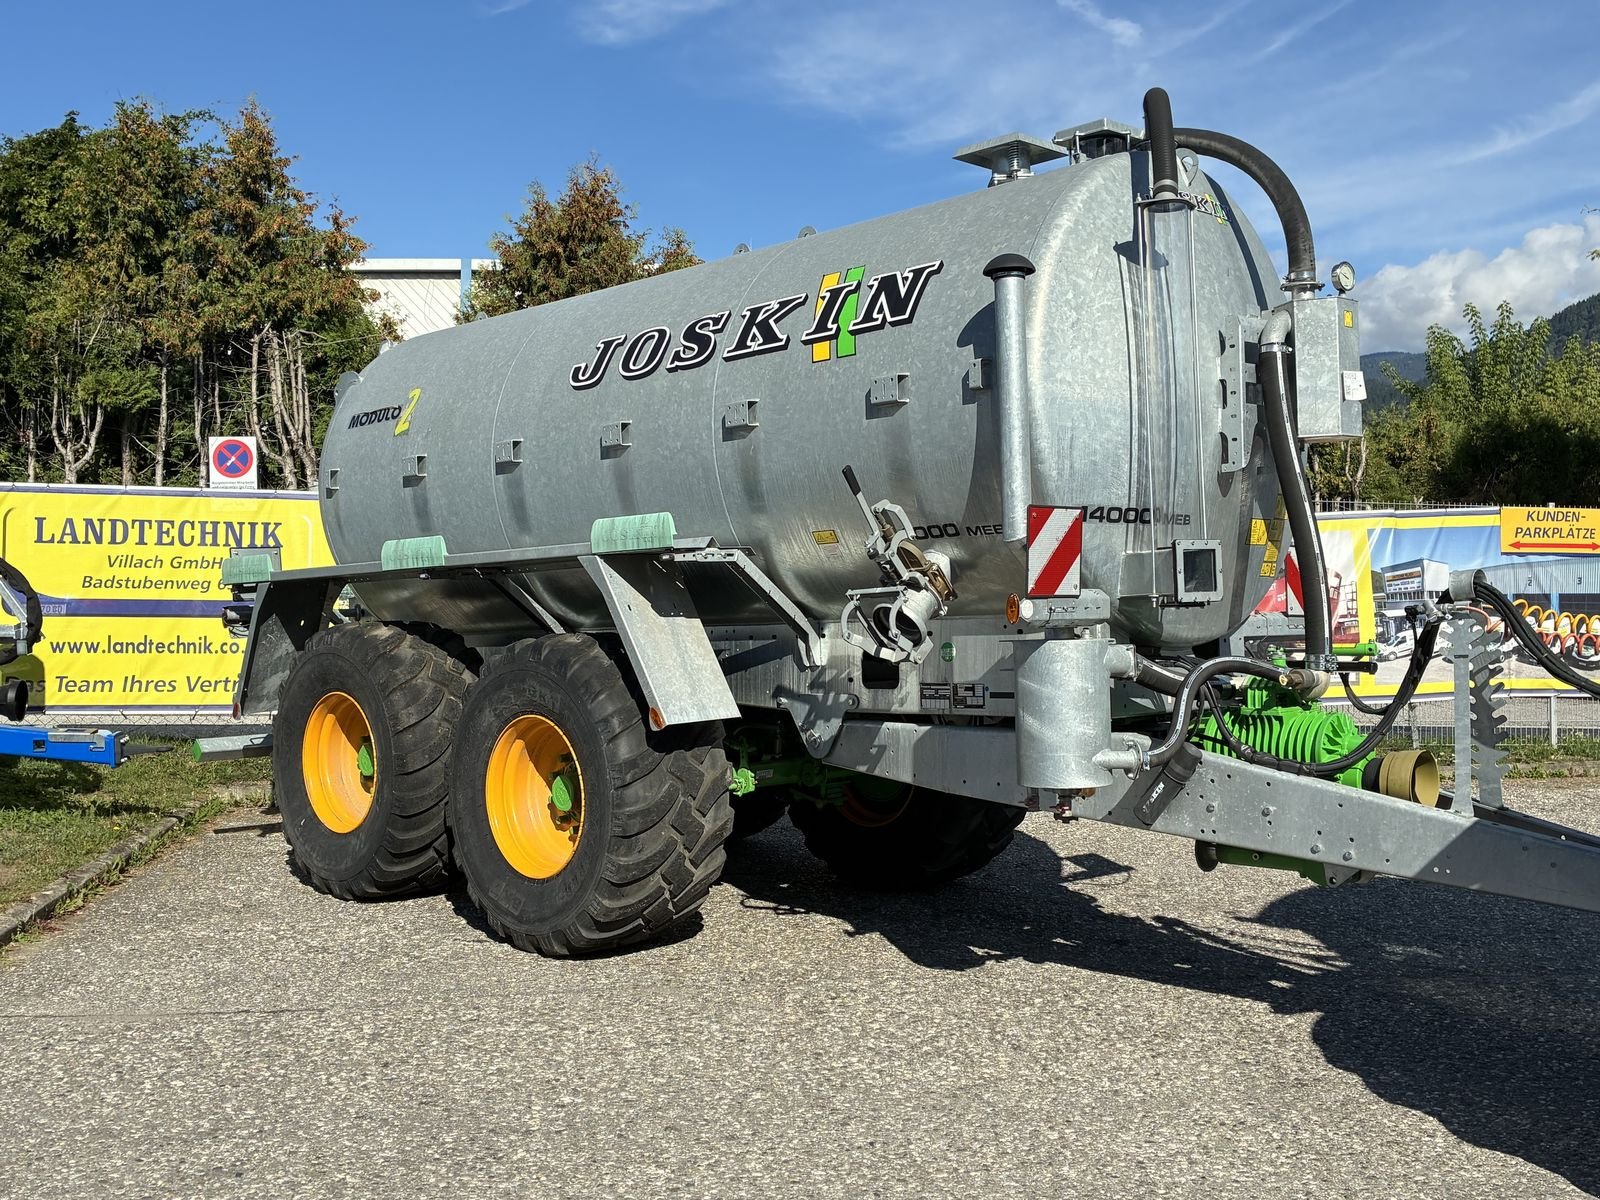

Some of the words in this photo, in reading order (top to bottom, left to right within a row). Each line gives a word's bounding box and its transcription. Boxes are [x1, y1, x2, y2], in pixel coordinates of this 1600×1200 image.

[569, 260, 944, 391] JOSKIN
[347, 404, 402, 429] MODULO
[393, 386, 421, 437] 2
[1526, 510, 1586, 522] KUNDEN-
[34, 517, 283, 548] LANDTECHNIK
[1514, 524, 1596, 539] PARKPLÄTZE
[107, 555, 163, 568] Villach
[170, 556, 223, 569] GmbH
[82, 576, 211, 593] Badstubenweg
[217, 579, 232, 591] 6
[56, 676, 113, 692] Team
[122, 675, 177, 692] Ihres
